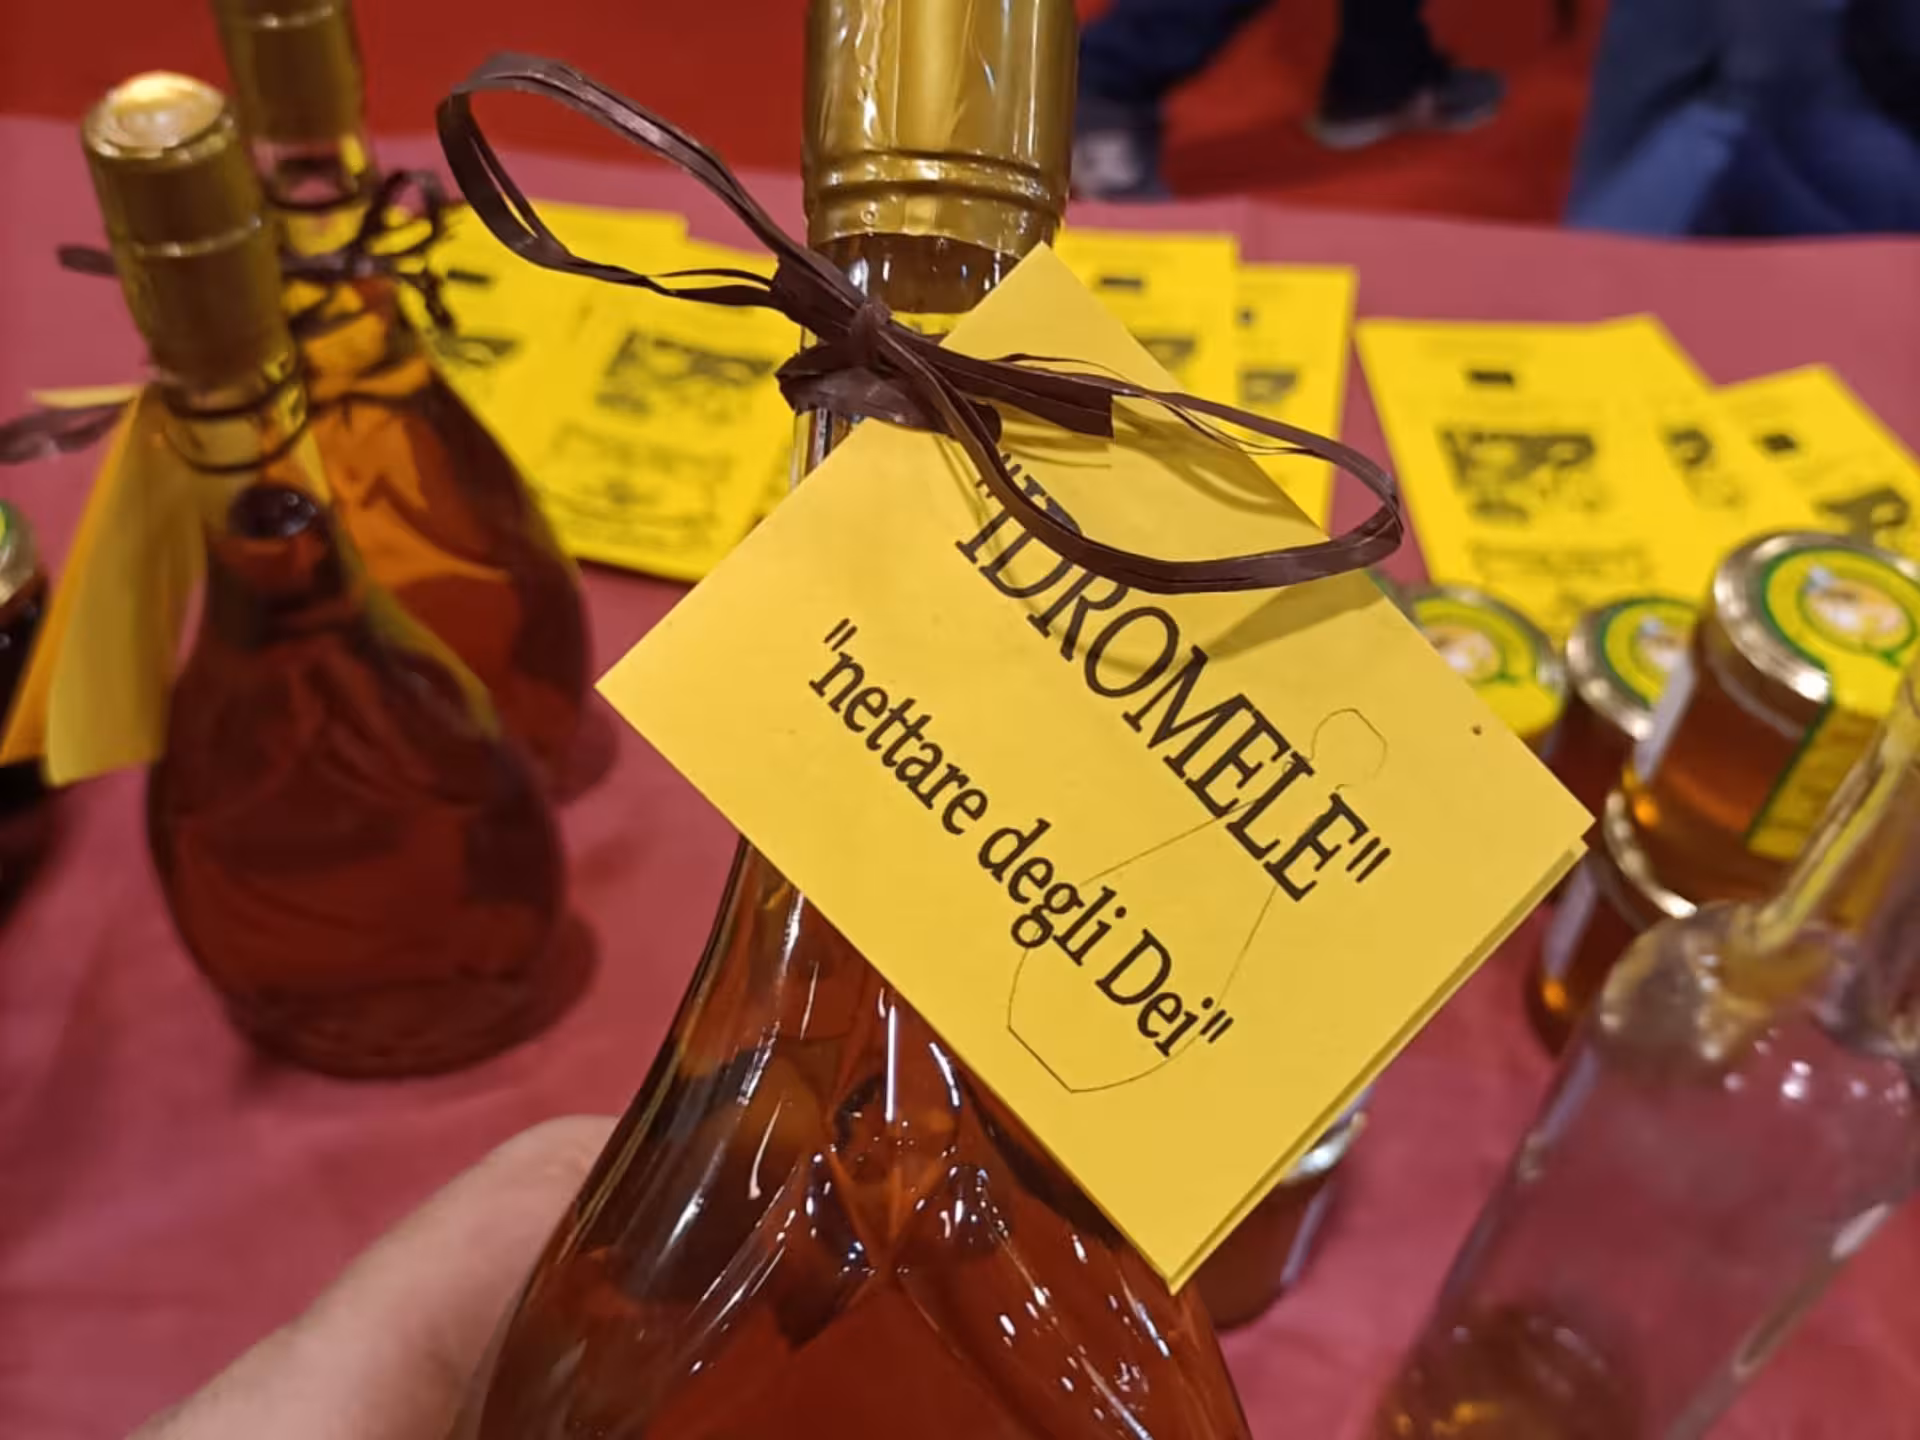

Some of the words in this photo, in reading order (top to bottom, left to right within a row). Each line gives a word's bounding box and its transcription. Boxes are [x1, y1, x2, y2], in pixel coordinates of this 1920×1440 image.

[809, 618, 989, 835] "nettare
[977, 818, 1128, 967] degli
[1095, 928, 1233, 1057] Dei"
